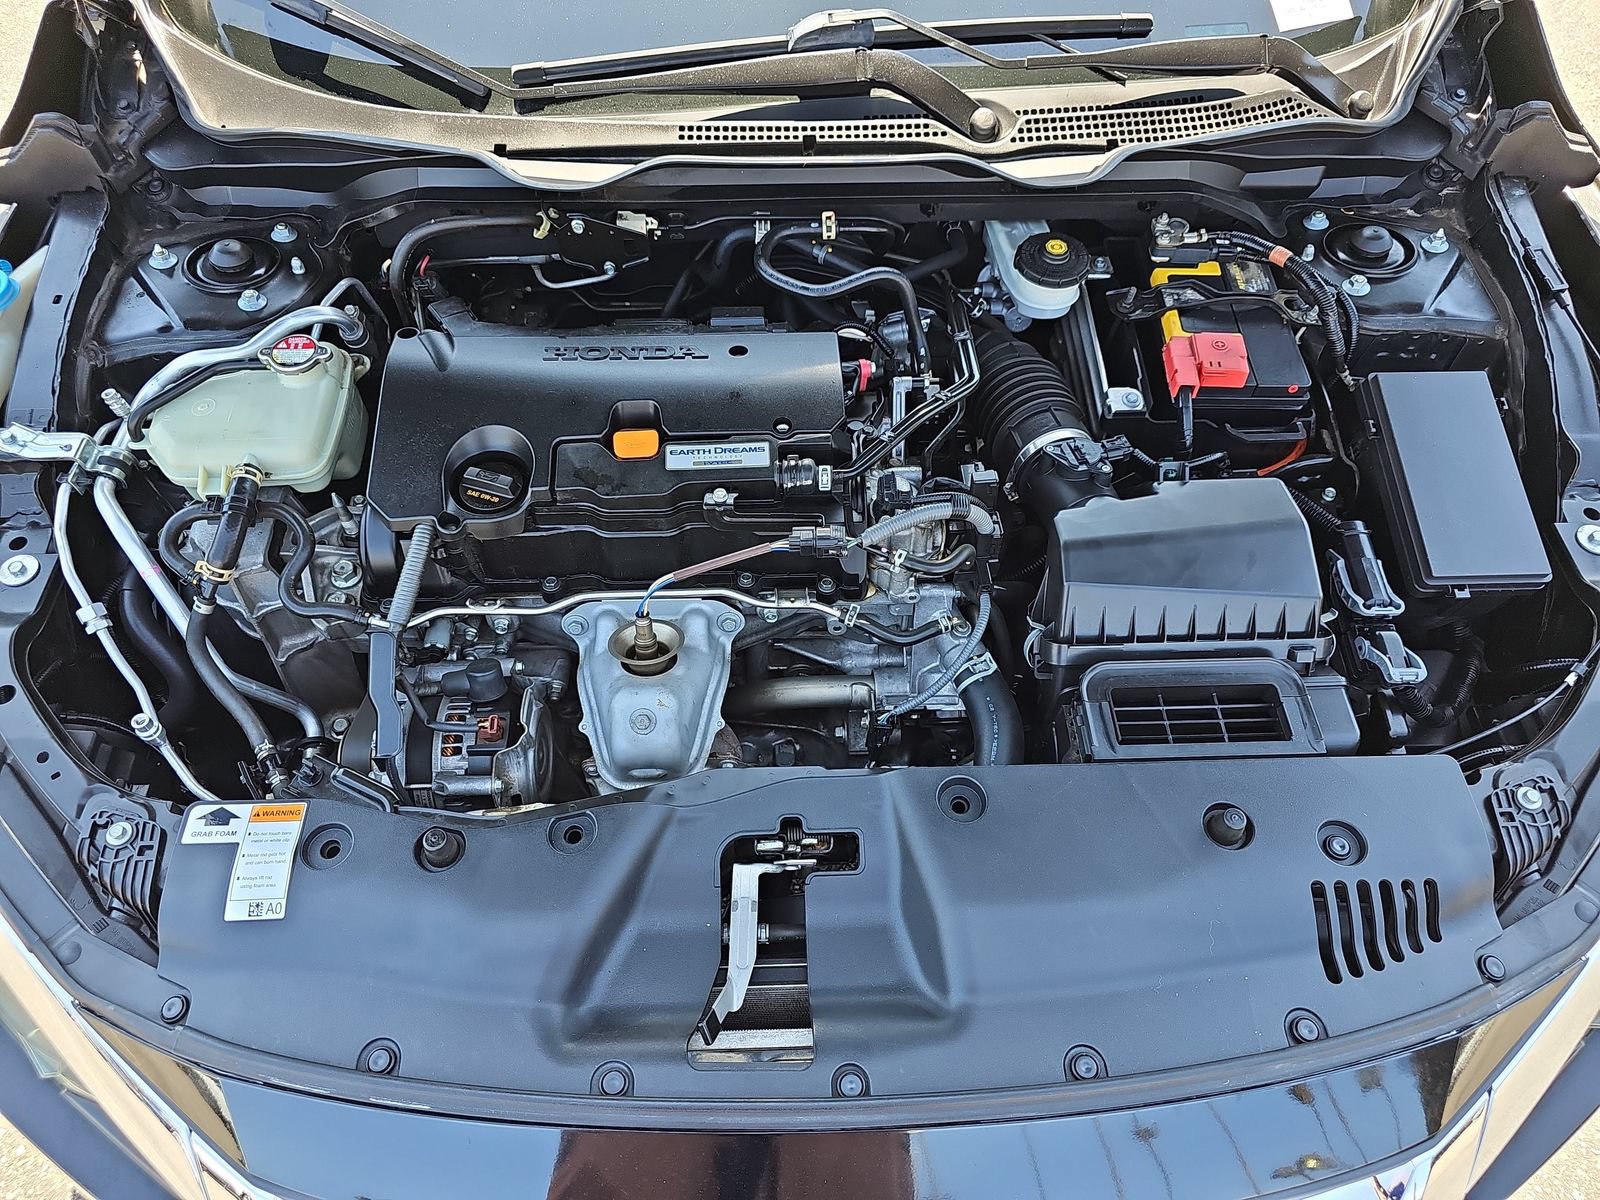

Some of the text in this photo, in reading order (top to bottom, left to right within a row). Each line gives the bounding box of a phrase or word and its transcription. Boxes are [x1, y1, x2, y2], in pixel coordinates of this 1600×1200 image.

[543, 345, 709, 361] HONDA
[669, 448, 712, 456] EARTH
[466, 489, 500, 503] SAE 0W-20
[262, 809, 302, 817] WARNING
[265, 902, 283, 915] A0
